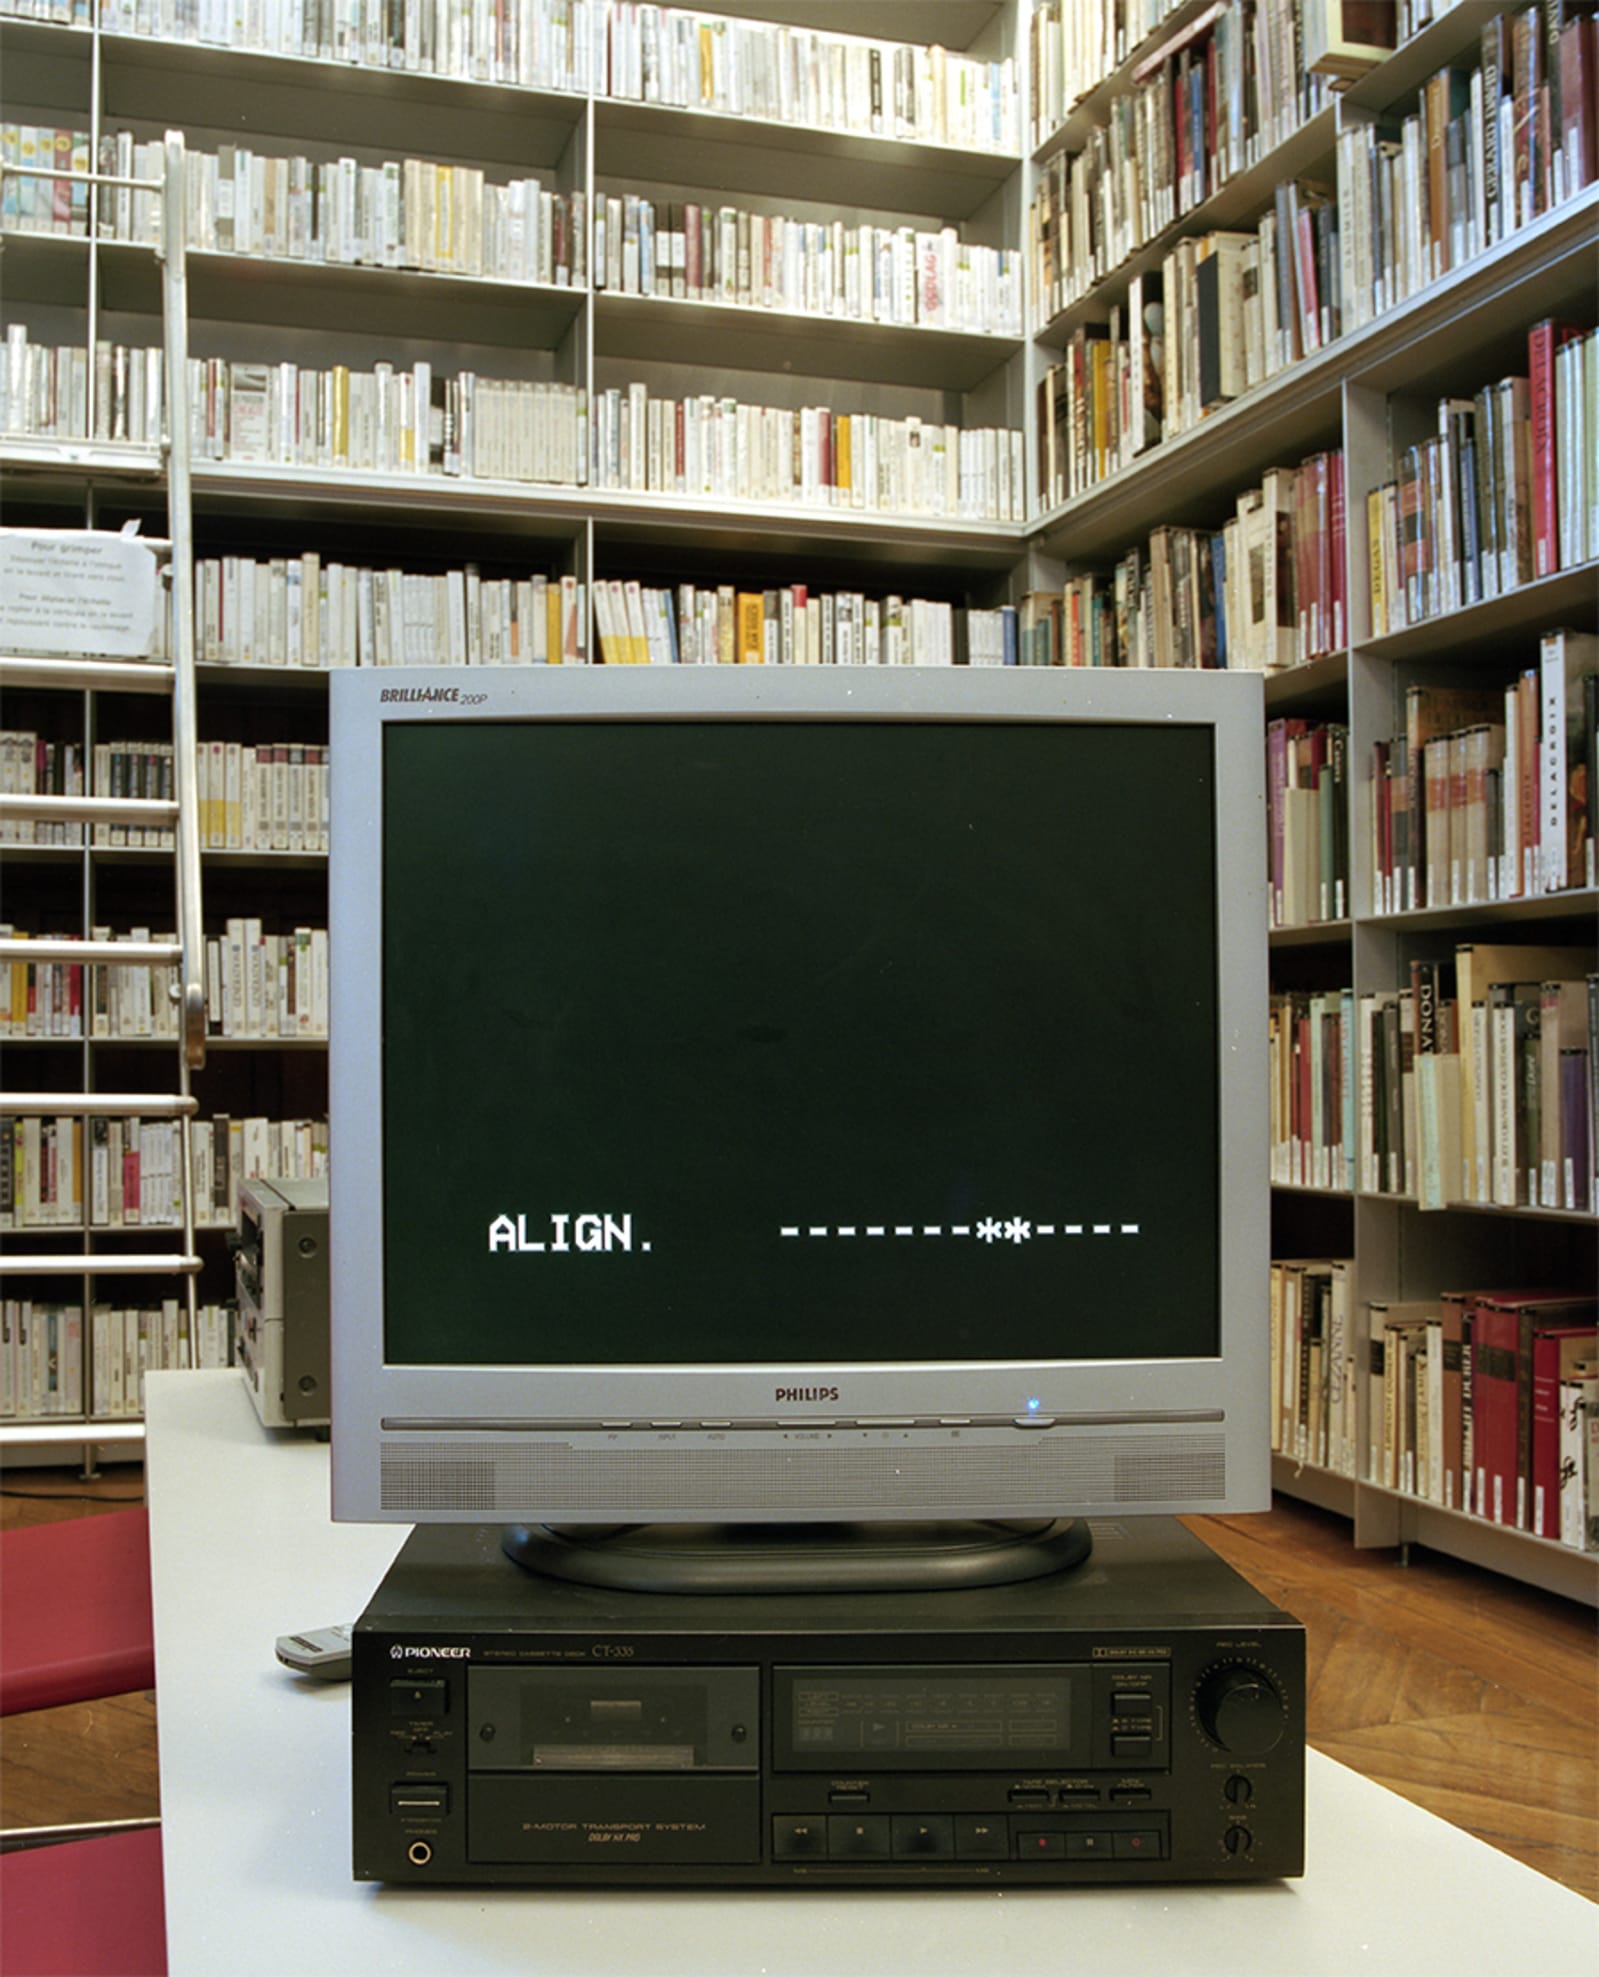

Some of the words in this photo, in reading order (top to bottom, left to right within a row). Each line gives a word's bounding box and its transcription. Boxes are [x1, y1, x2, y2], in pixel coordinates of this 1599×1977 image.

[379, 687, 460, 703] BRILLIANCE
[1548, 696, 1557, 827] DELACROIX
[488, 1213, 652, 1252] ALIGN.
[775, 1387, 839, 1401] PHILIPS
[405, 1647, 471, 1658] PIONEER
[582, 1823, 652, 1831] TRANSPORT
[655, 1823, 707, 1831] SYSTEM
